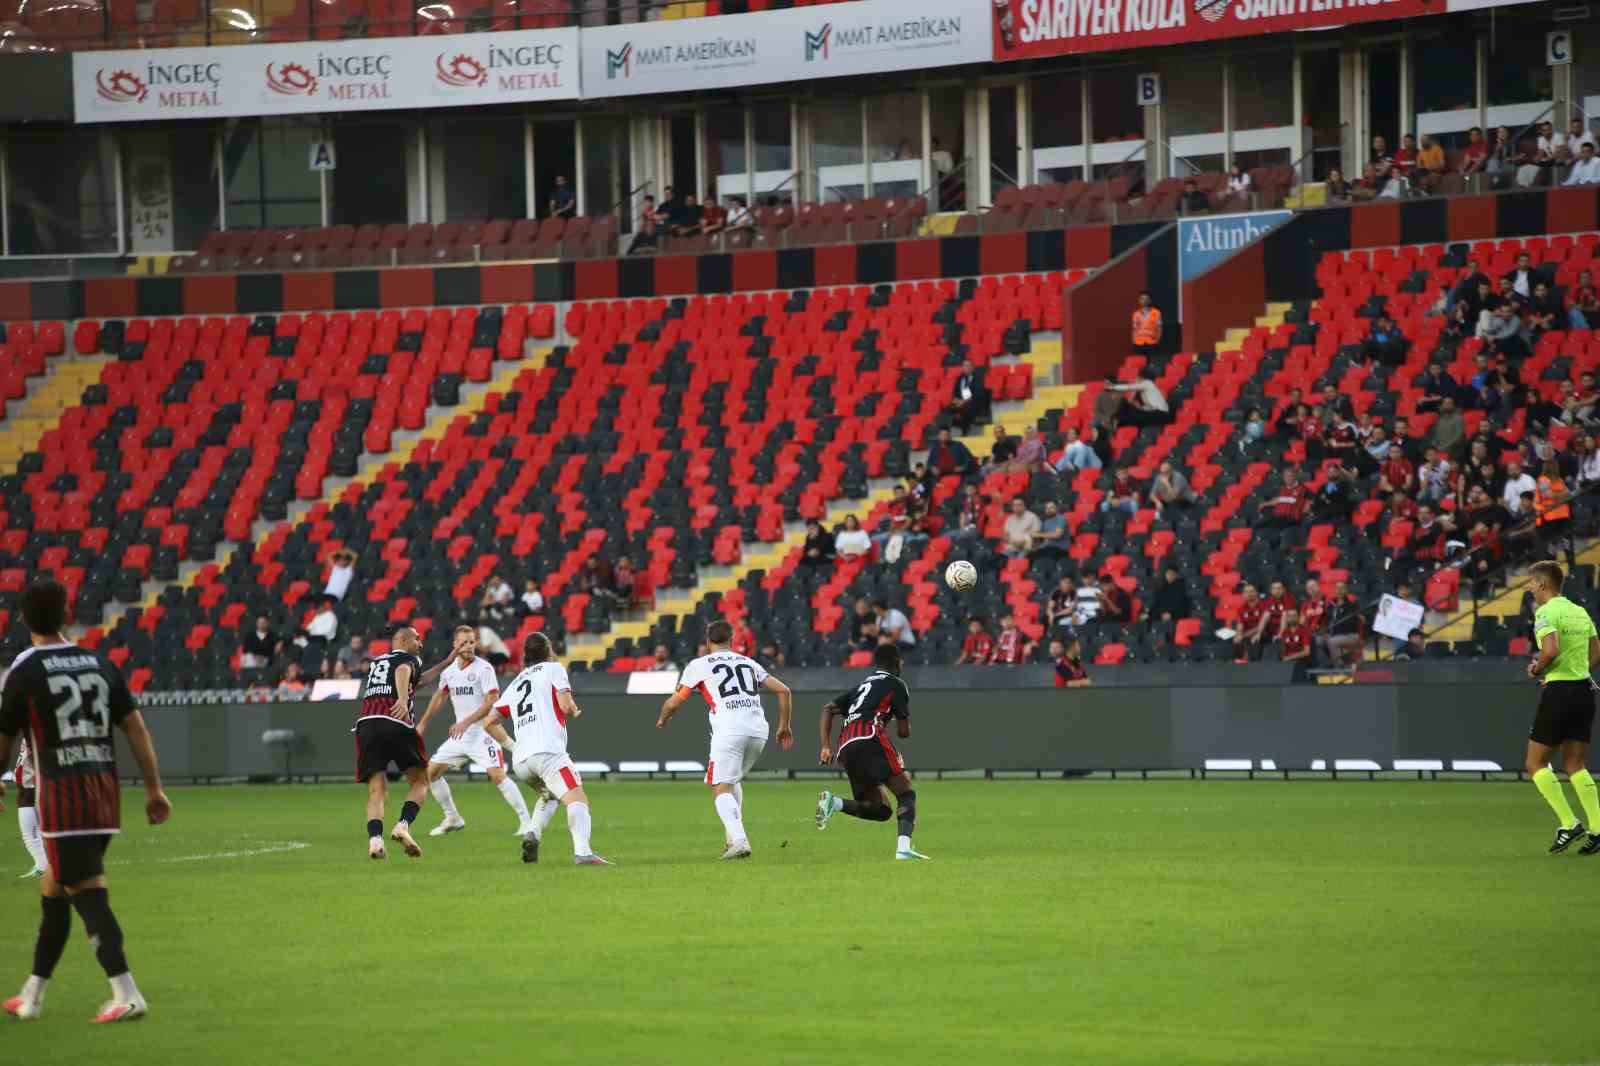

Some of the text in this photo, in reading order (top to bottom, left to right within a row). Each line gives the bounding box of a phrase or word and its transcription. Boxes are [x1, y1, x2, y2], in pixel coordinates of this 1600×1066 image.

[835, 26, 873, 47] MMT
[876, 16, 961, 43] AMERİKAN
[1020, 0, 1187, 42] SARIYER KOLA
[489, 44, 564, 69] İNGEÇ
[636, 37, 757, 65] MMT AMERİKAN
[148, 61, 222, 88] İNGEÇ
[318, 53, 392, 80] İNGEÇ
[328, 83, 392, 101] METAL
[500, 72, 563, 90] METAL
[159, 91, 222, 108] METAL
[315, 143, 331, 166] A
[367, 659, 390, 688] 19
[712, 663, 758, 698] 20
[48, 672, 110, 741] 23
[517, 679, 533, 717] 2
[487, 745, 497, 759] 6
